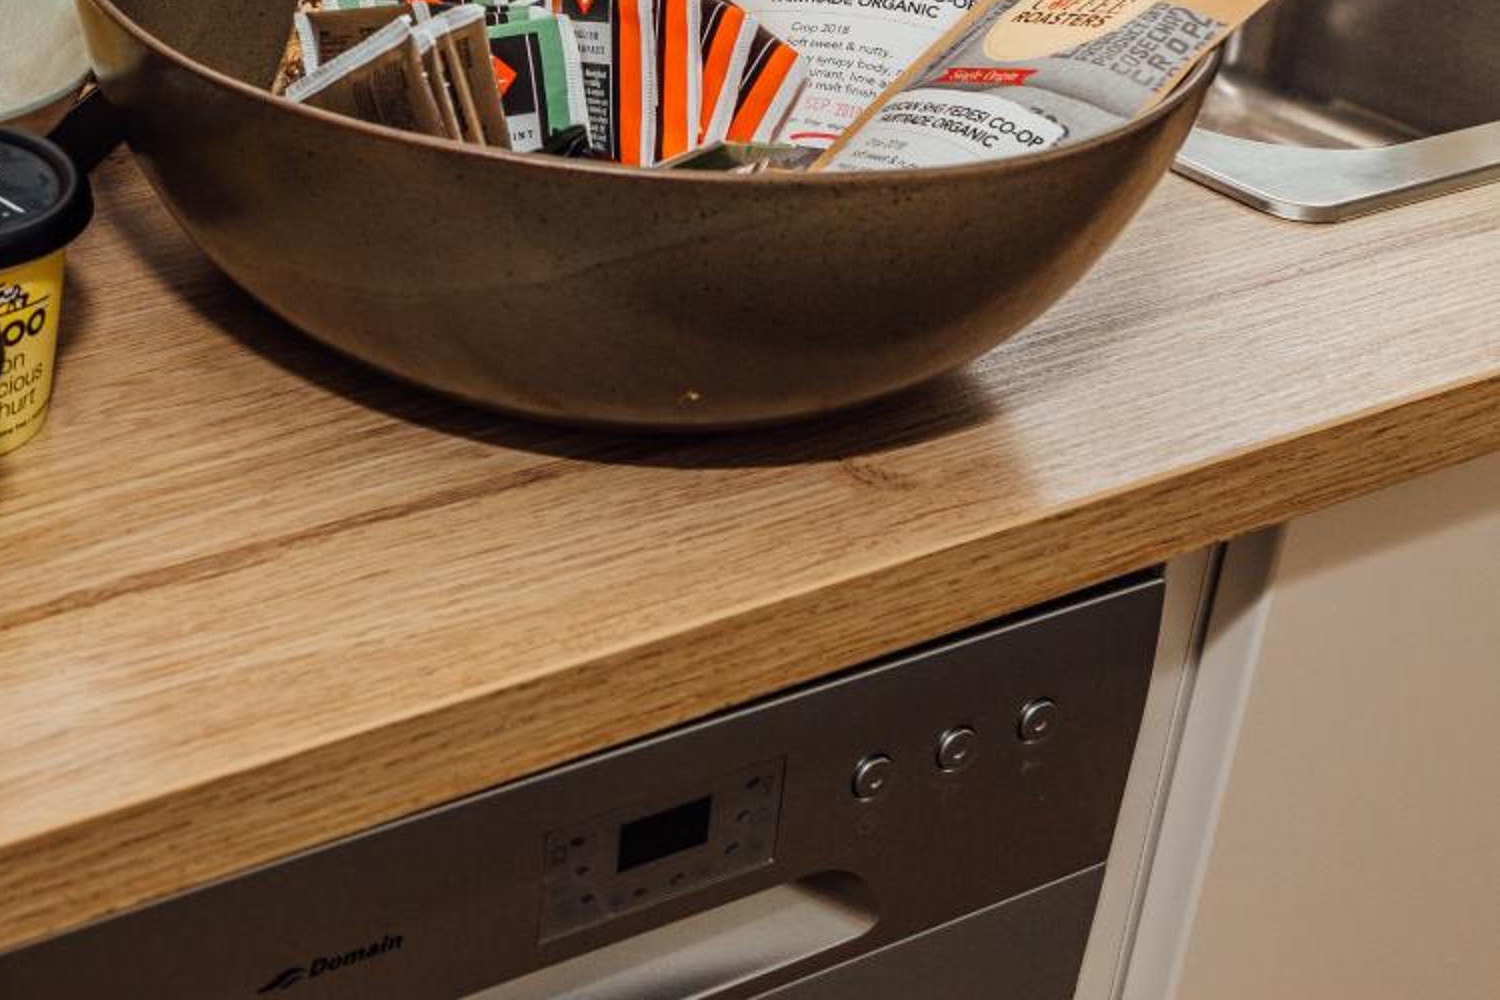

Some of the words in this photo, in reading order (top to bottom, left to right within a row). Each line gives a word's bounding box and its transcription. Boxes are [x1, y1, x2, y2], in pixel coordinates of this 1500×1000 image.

[791, 21, 819, 33] Crop
[1011, 10, 1114, 28] ROASTERS
[845, 41, 855, 51] &
[931, 116, 1000, 149] ORGANIC
[988, 116, 1045, 148] CO-OP
[2, 307, 46, 347] oo
[308, 935, 404, 978] Domain
